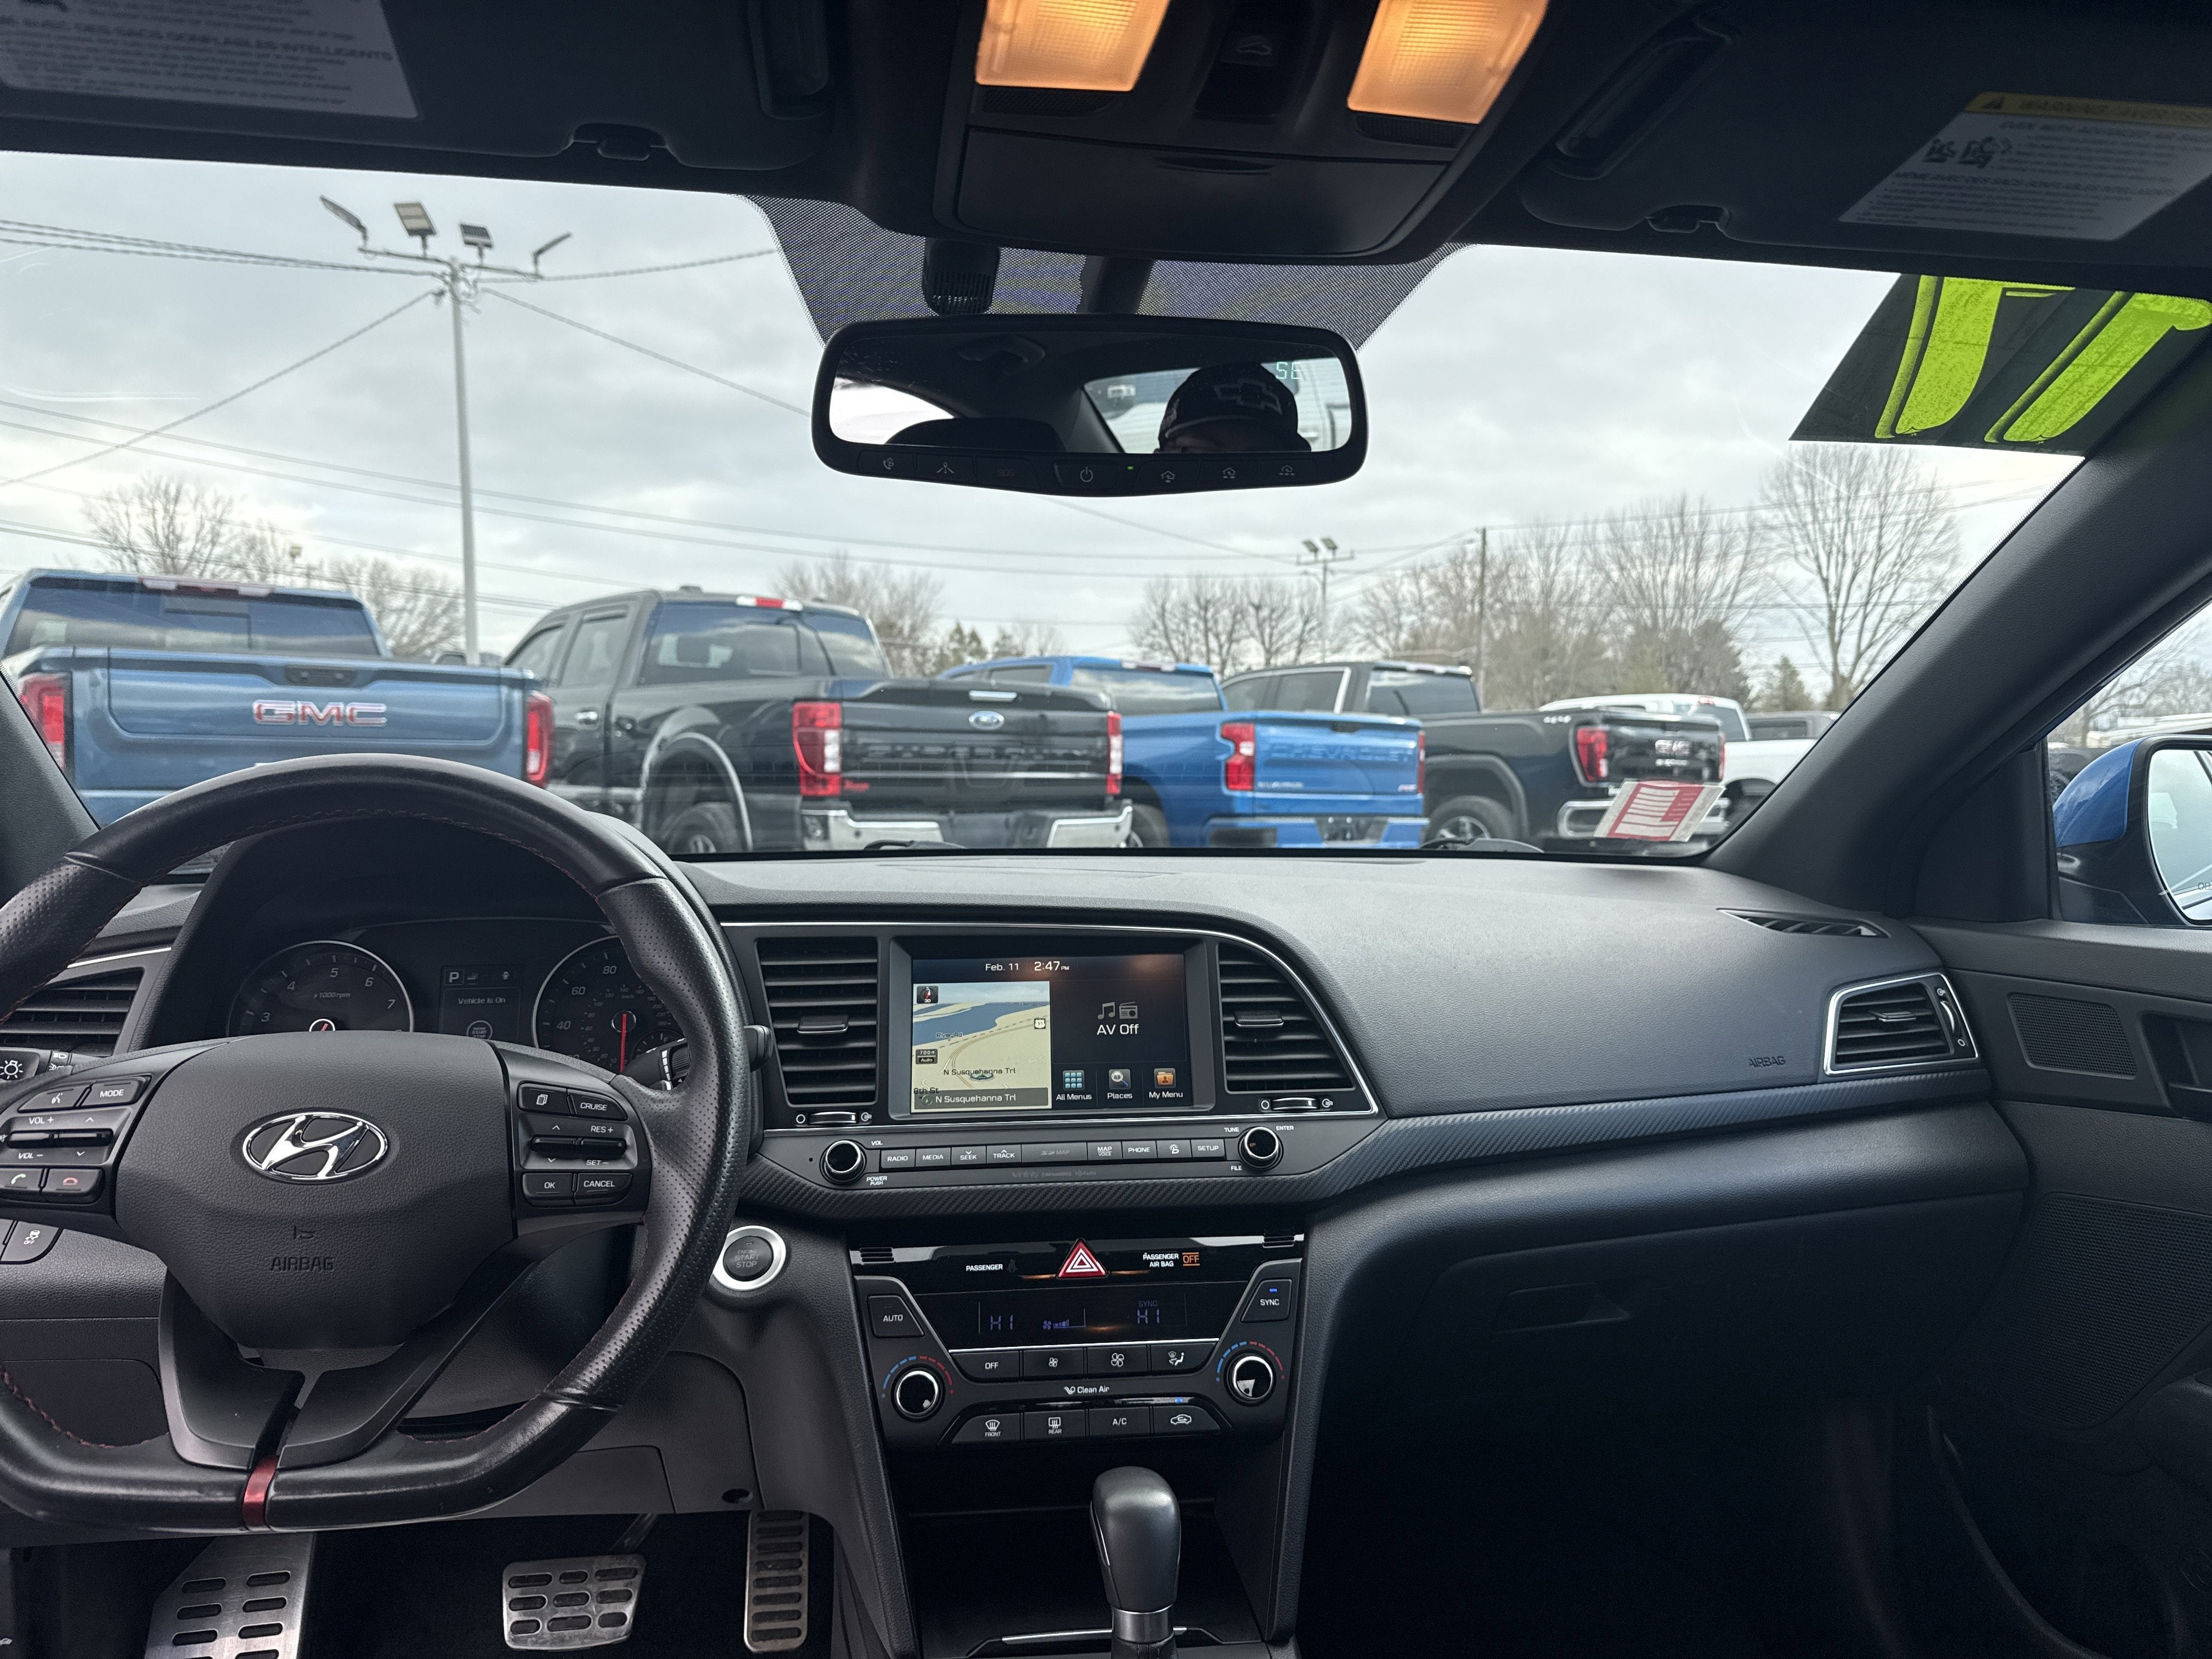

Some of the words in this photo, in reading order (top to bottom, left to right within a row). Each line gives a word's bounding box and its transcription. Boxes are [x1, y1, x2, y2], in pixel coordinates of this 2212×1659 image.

[1276, 361, 1300, 380] SE
[997, 469, 1015, 477] SOS
[253, 700, 387, 727] GMC
[602, 966, 617, 975] 80
[985, 963, 1006, 972] Feb.
[1034, 961, 1060, 971] 2:47
[330, 967, 339, 978] 5
[449, 972, 460, 983] P
[287, 981, 296, 990] 4
[365, 977, 374, 987] 6
[571, 986, 585, 995] 60
[387, 999, 396, 1009] 7
[261, 1012, 270, 1022] 3
[556, 1020, 571, 1030] 40
[1097, 1025, 1115, 1035] AV
[1120, 1024, 1139, 1035] Off
[1749, 1056, 1786, 1067] AIRBAG
[100, 1089, 124, 1098] MODE
[944, 1094, 1002, 1104] Susquehanna
[580, 1102, 607, 1111] CRUISE
[270, 1256, 335, 1272] AIRBAG
[1183, 1255, 1199, 1263] OFF
[966, 1263, 1003, 1272] PASSENGER
[1113, 1417, 1127, 1426] A/C
